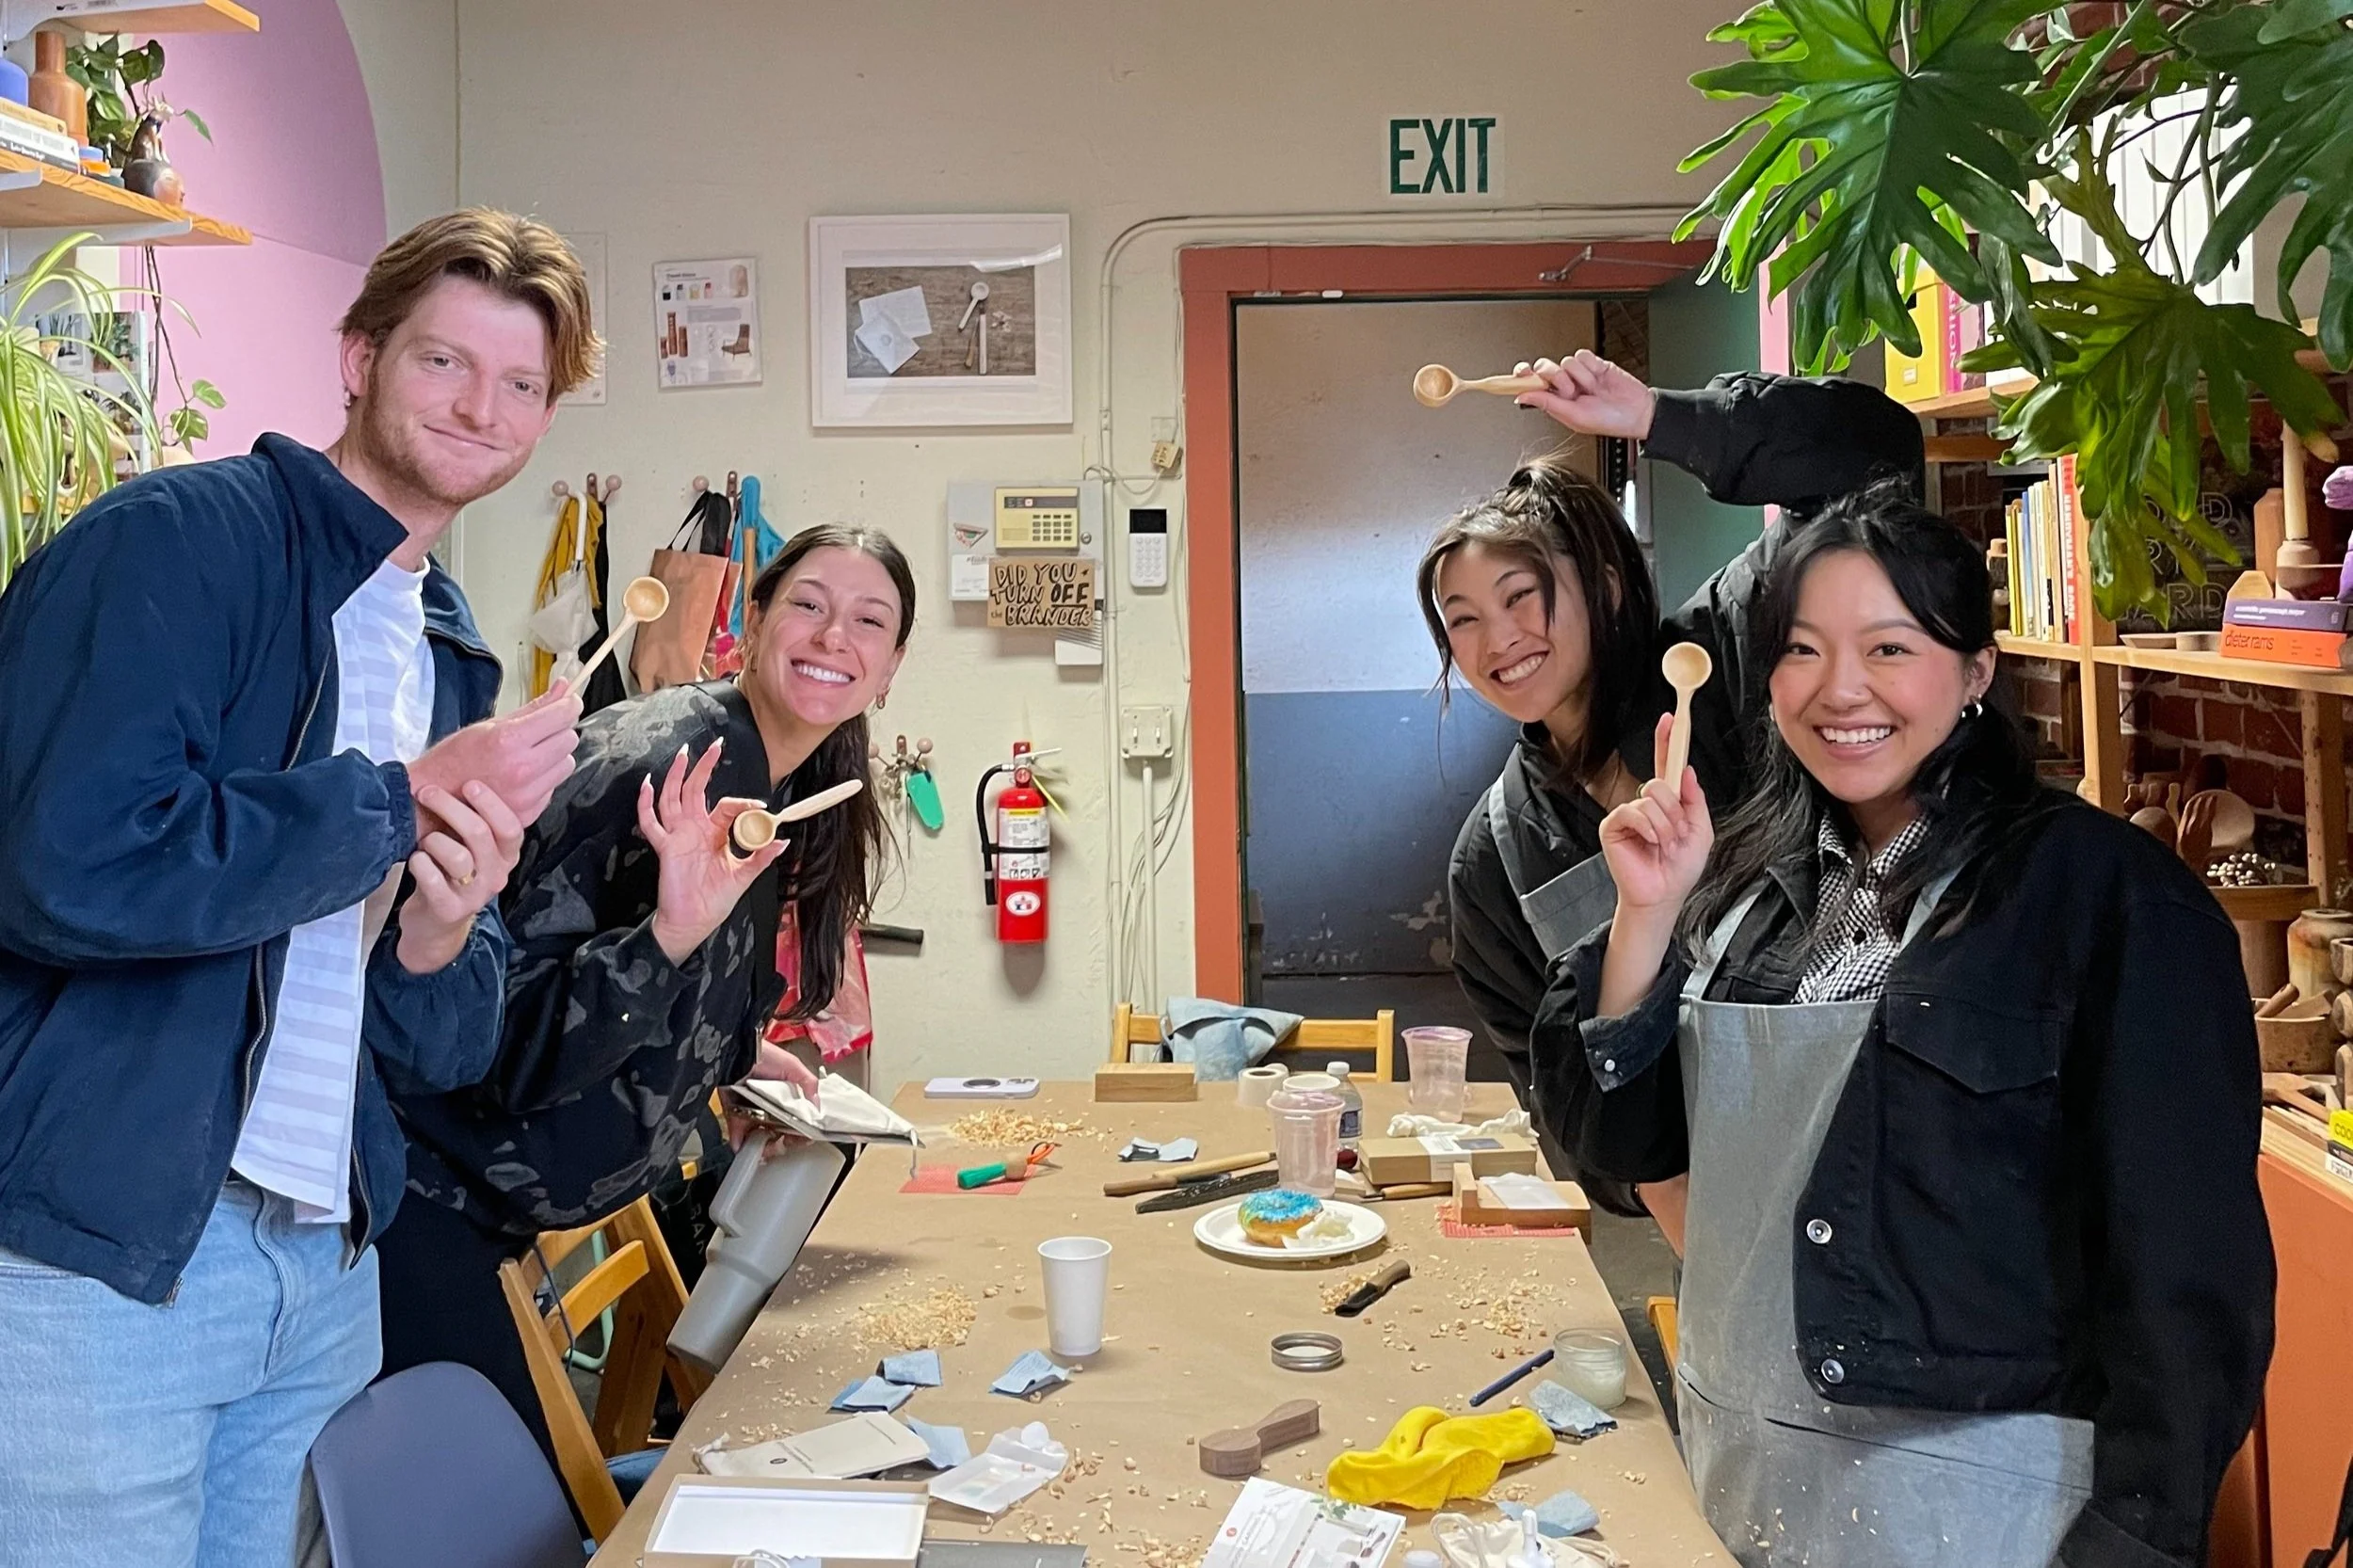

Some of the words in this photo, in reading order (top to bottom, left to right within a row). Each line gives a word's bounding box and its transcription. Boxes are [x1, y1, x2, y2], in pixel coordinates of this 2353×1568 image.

[1390, 118, 1496, 194] EXIT
[995, 564, 1027, 587] DID
[1034, 563, 1077, 584] YOU
[990, 584, 1044, 605] TURN
[1051, 583, 1089, 602] OFF
[1005, 602, 1093, 626] BRANDER
